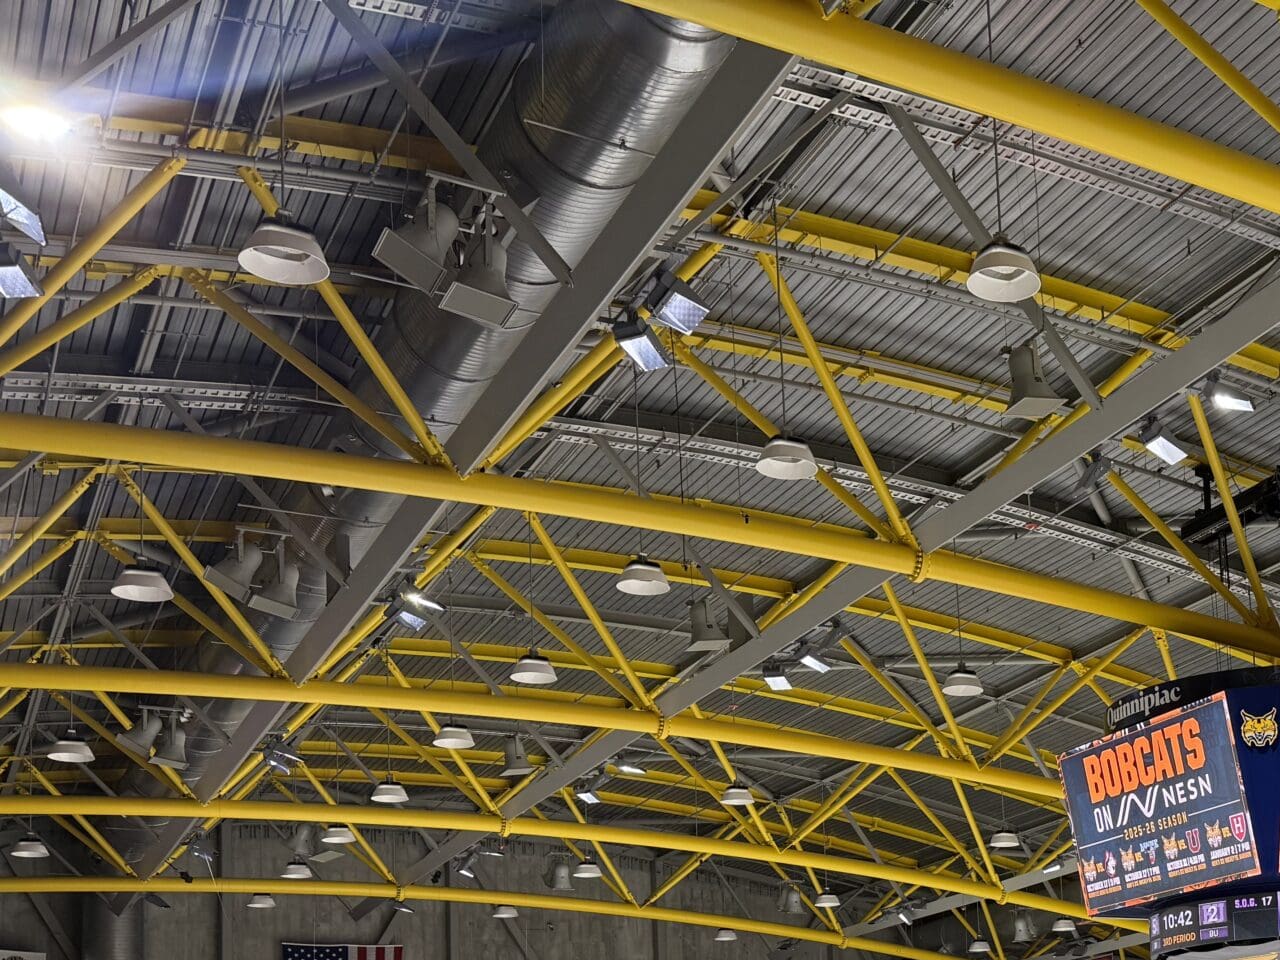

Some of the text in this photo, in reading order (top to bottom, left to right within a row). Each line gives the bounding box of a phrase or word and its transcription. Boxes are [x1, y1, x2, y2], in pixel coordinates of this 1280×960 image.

[1107, 686, 1181, 728] Quinnipiac
[1083, 717, 1206, 803] BOBCATS
[1093, 774, 1212, 832] ON NESN
[1123, 811, 1188, 841] 2025-26 SEASON
[1163, 905, 1218, 930] 10:42 2
[1234, 896, 1273, 909] S.O.G. 17
[1173, 932, 1196, 945] PERIOD
